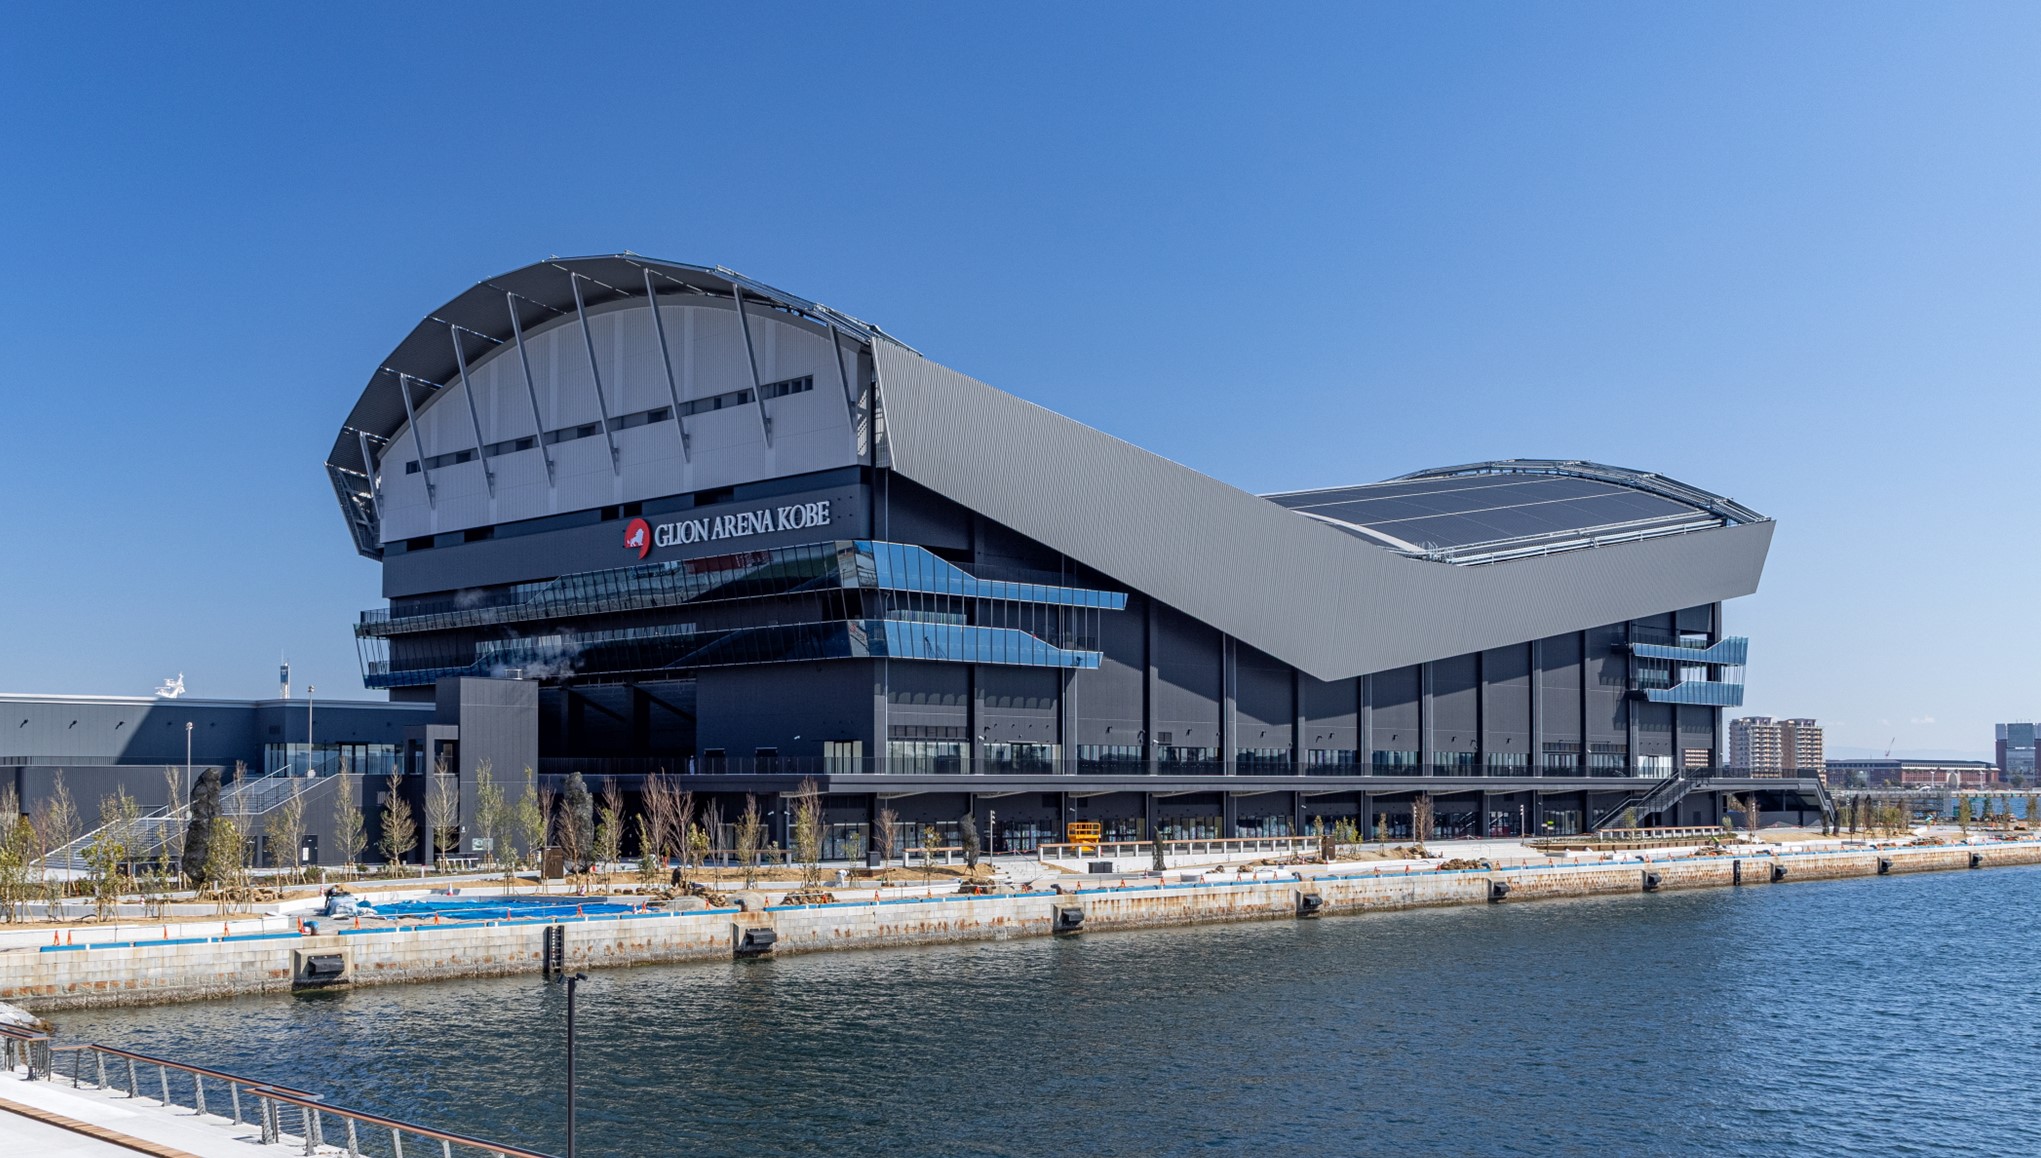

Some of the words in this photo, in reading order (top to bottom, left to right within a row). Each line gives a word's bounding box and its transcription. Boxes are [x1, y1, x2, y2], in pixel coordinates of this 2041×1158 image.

[654, 518, 709, 548] GLION
[711, 509, 775, 540] ARENA
[777, 501, 830, 531] KOBE
